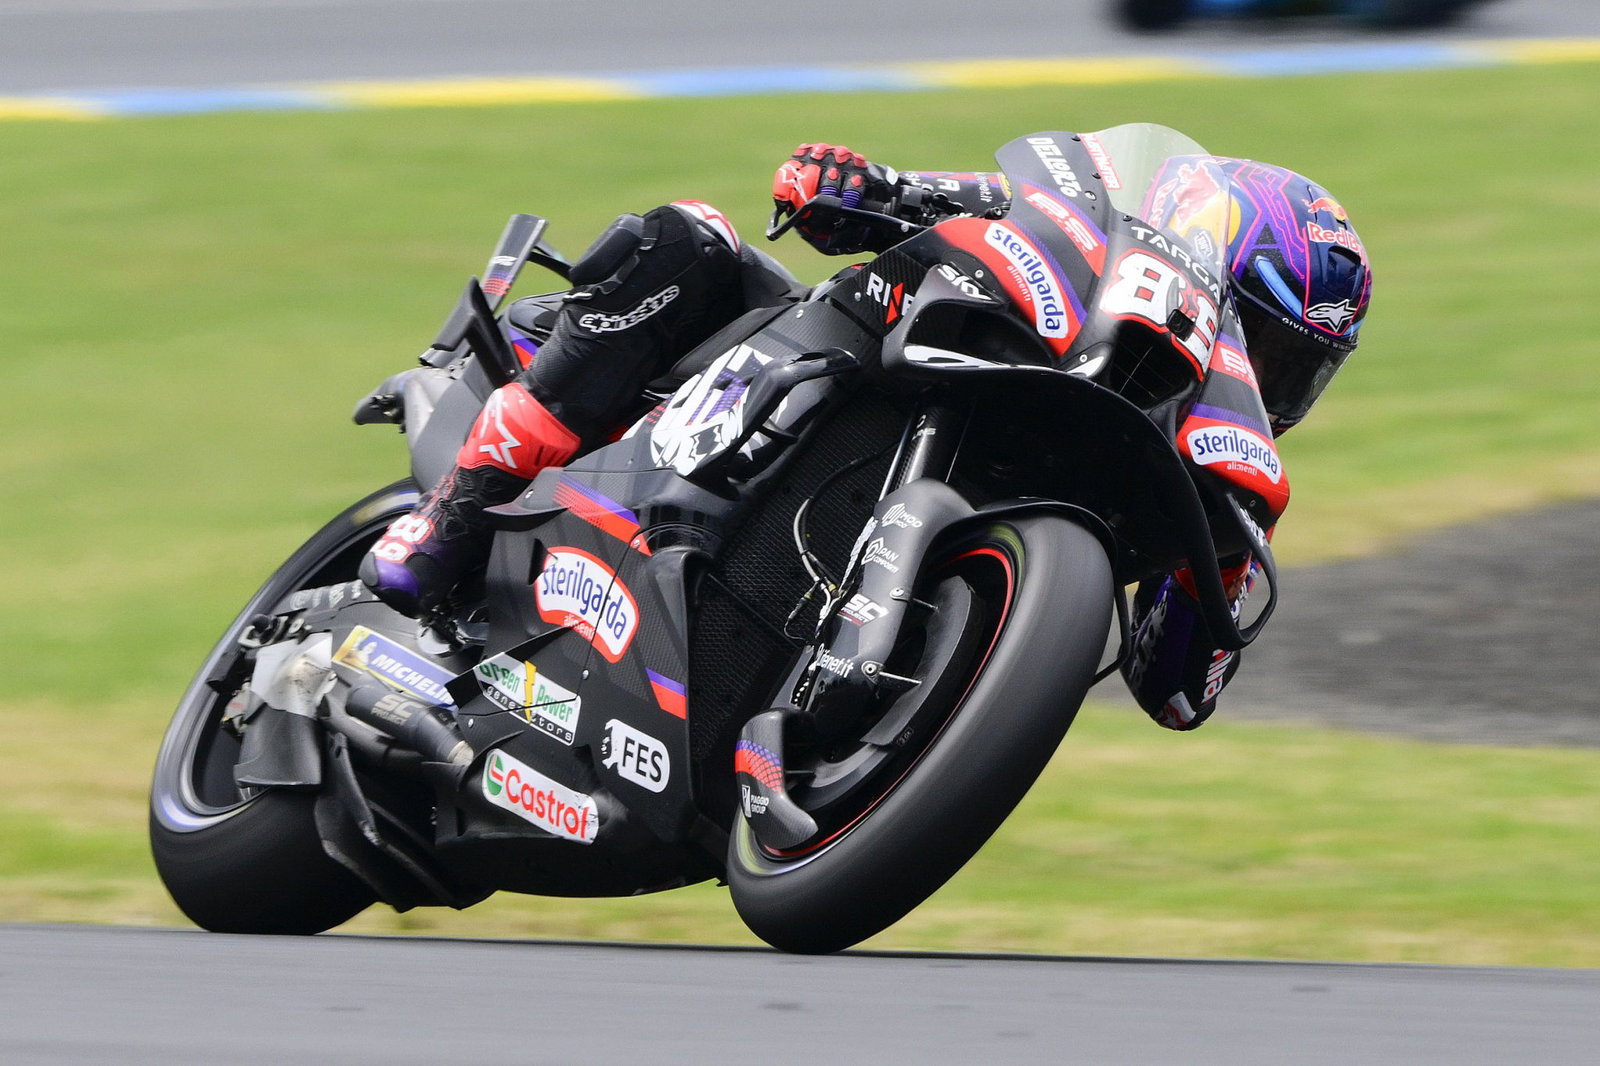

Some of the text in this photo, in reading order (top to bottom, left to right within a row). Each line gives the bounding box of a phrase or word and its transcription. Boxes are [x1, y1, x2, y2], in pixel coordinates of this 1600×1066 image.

[991, 228, 1061, 332] sterilgarda
[1006, 265, 1032, 302] alimenti
[1281, 316, 1309, 336] GIVES
[1313, 332, 1331, 346] YOU
[1194, 430, 1278, 475] sterilgarda
[1226, 462, 1257, 476] alimenti
[880, 547, 900, 562] PAN
[543, 560, 627, 640] sterilgarda
[371, 653, 455, 706] MICHELIN
[536, 684, 573, 723] Power
[621, 736, 663, 783] FES
[505, 768, 591, 839] Castrol
